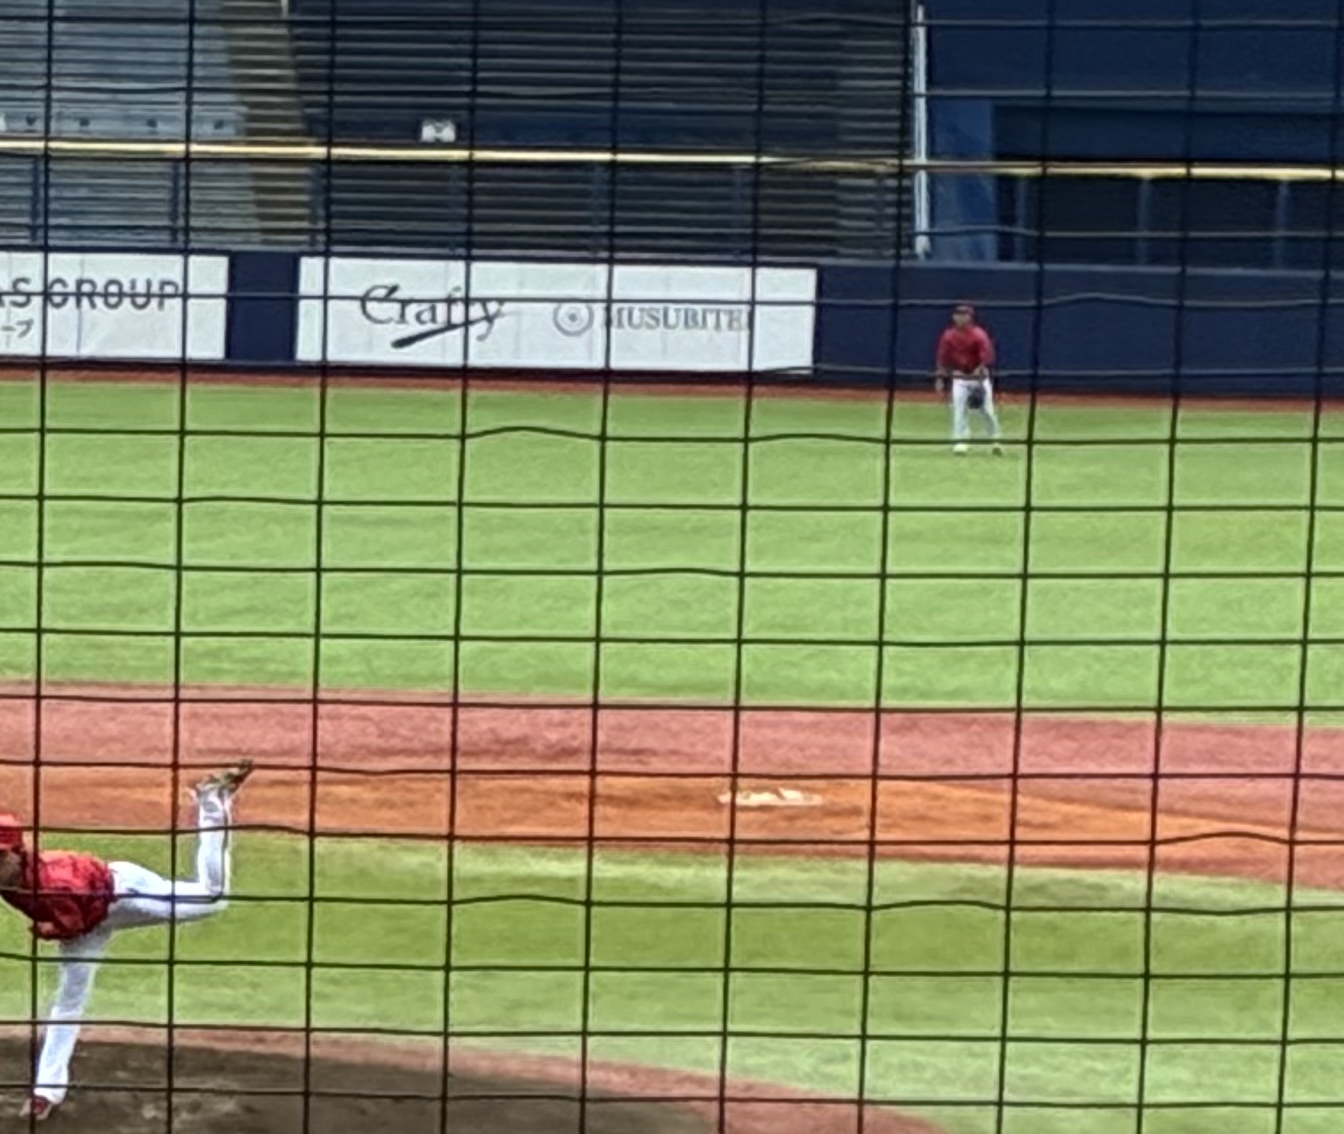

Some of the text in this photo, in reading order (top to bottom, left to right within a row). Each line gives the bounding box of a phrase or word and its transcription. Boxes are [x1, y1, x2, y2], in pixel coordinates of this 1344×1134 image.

[47, 277, 180, 311] GROUP
[360, 284, 508, 343] Crafy
[601, 305, 753, 332] MUSUBITE
